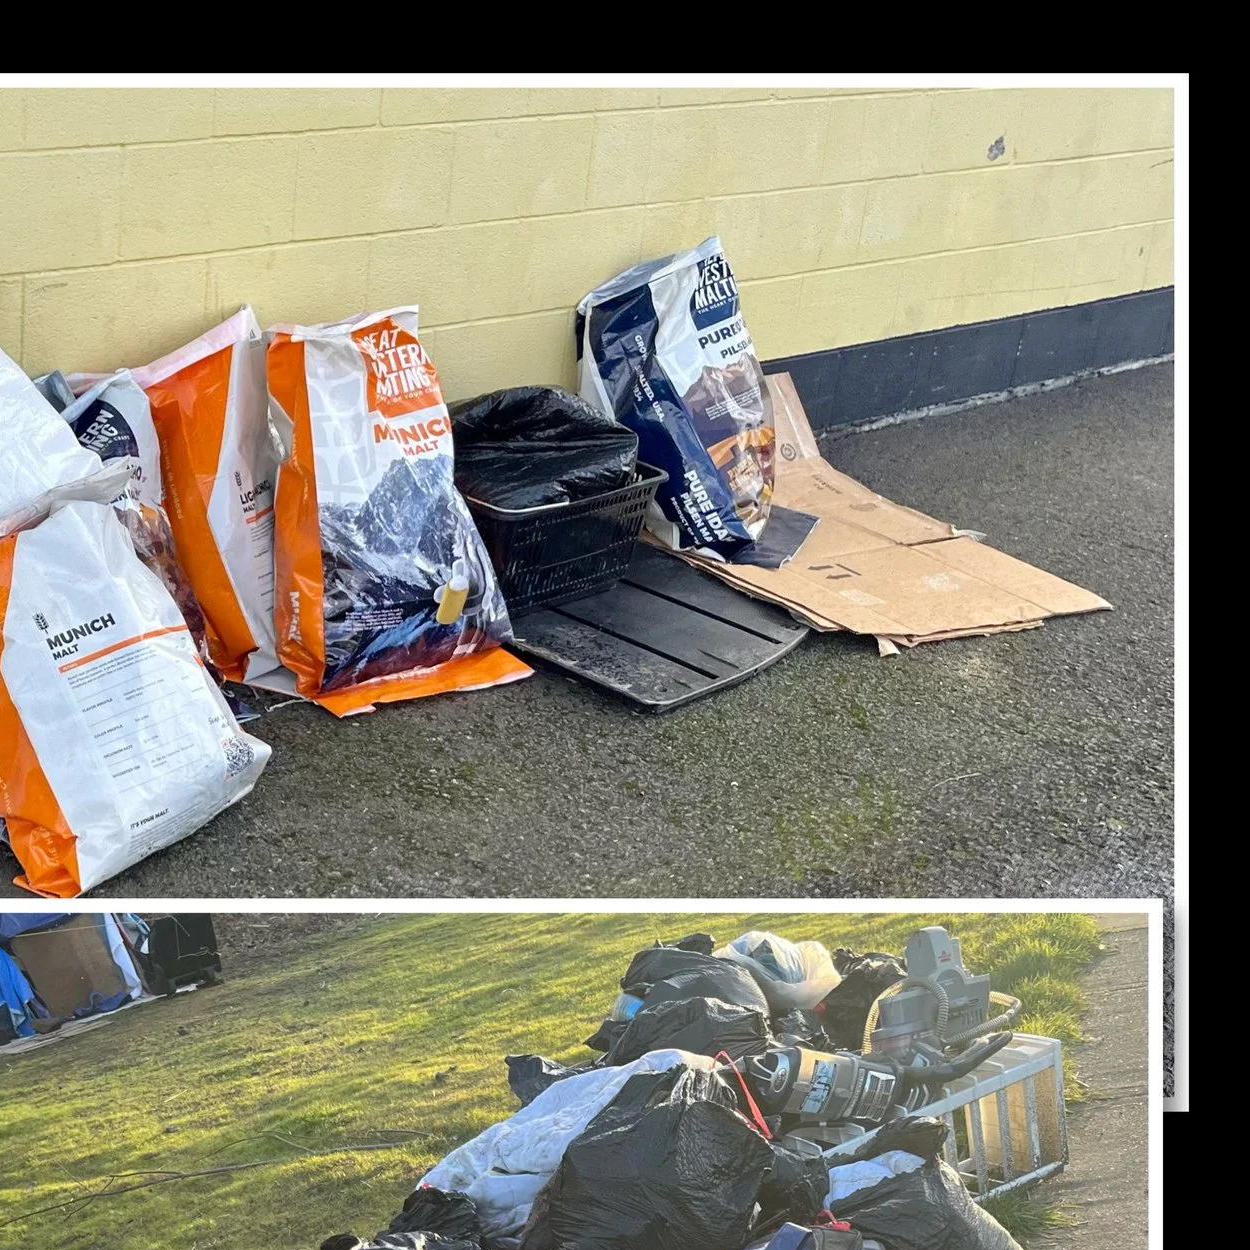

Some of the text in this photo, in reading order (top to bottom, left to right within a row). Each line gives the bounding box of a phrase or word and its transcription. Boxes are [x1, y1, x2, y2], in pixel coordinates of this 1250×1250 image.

[402, 439, 440, 457] MALT
[683, 469, 715, 514] PURE
[680, 492, 705, 529] PILSEN
[45, 612, 117, 651] MUNICH
[51, 643, 80, 661] MALT
